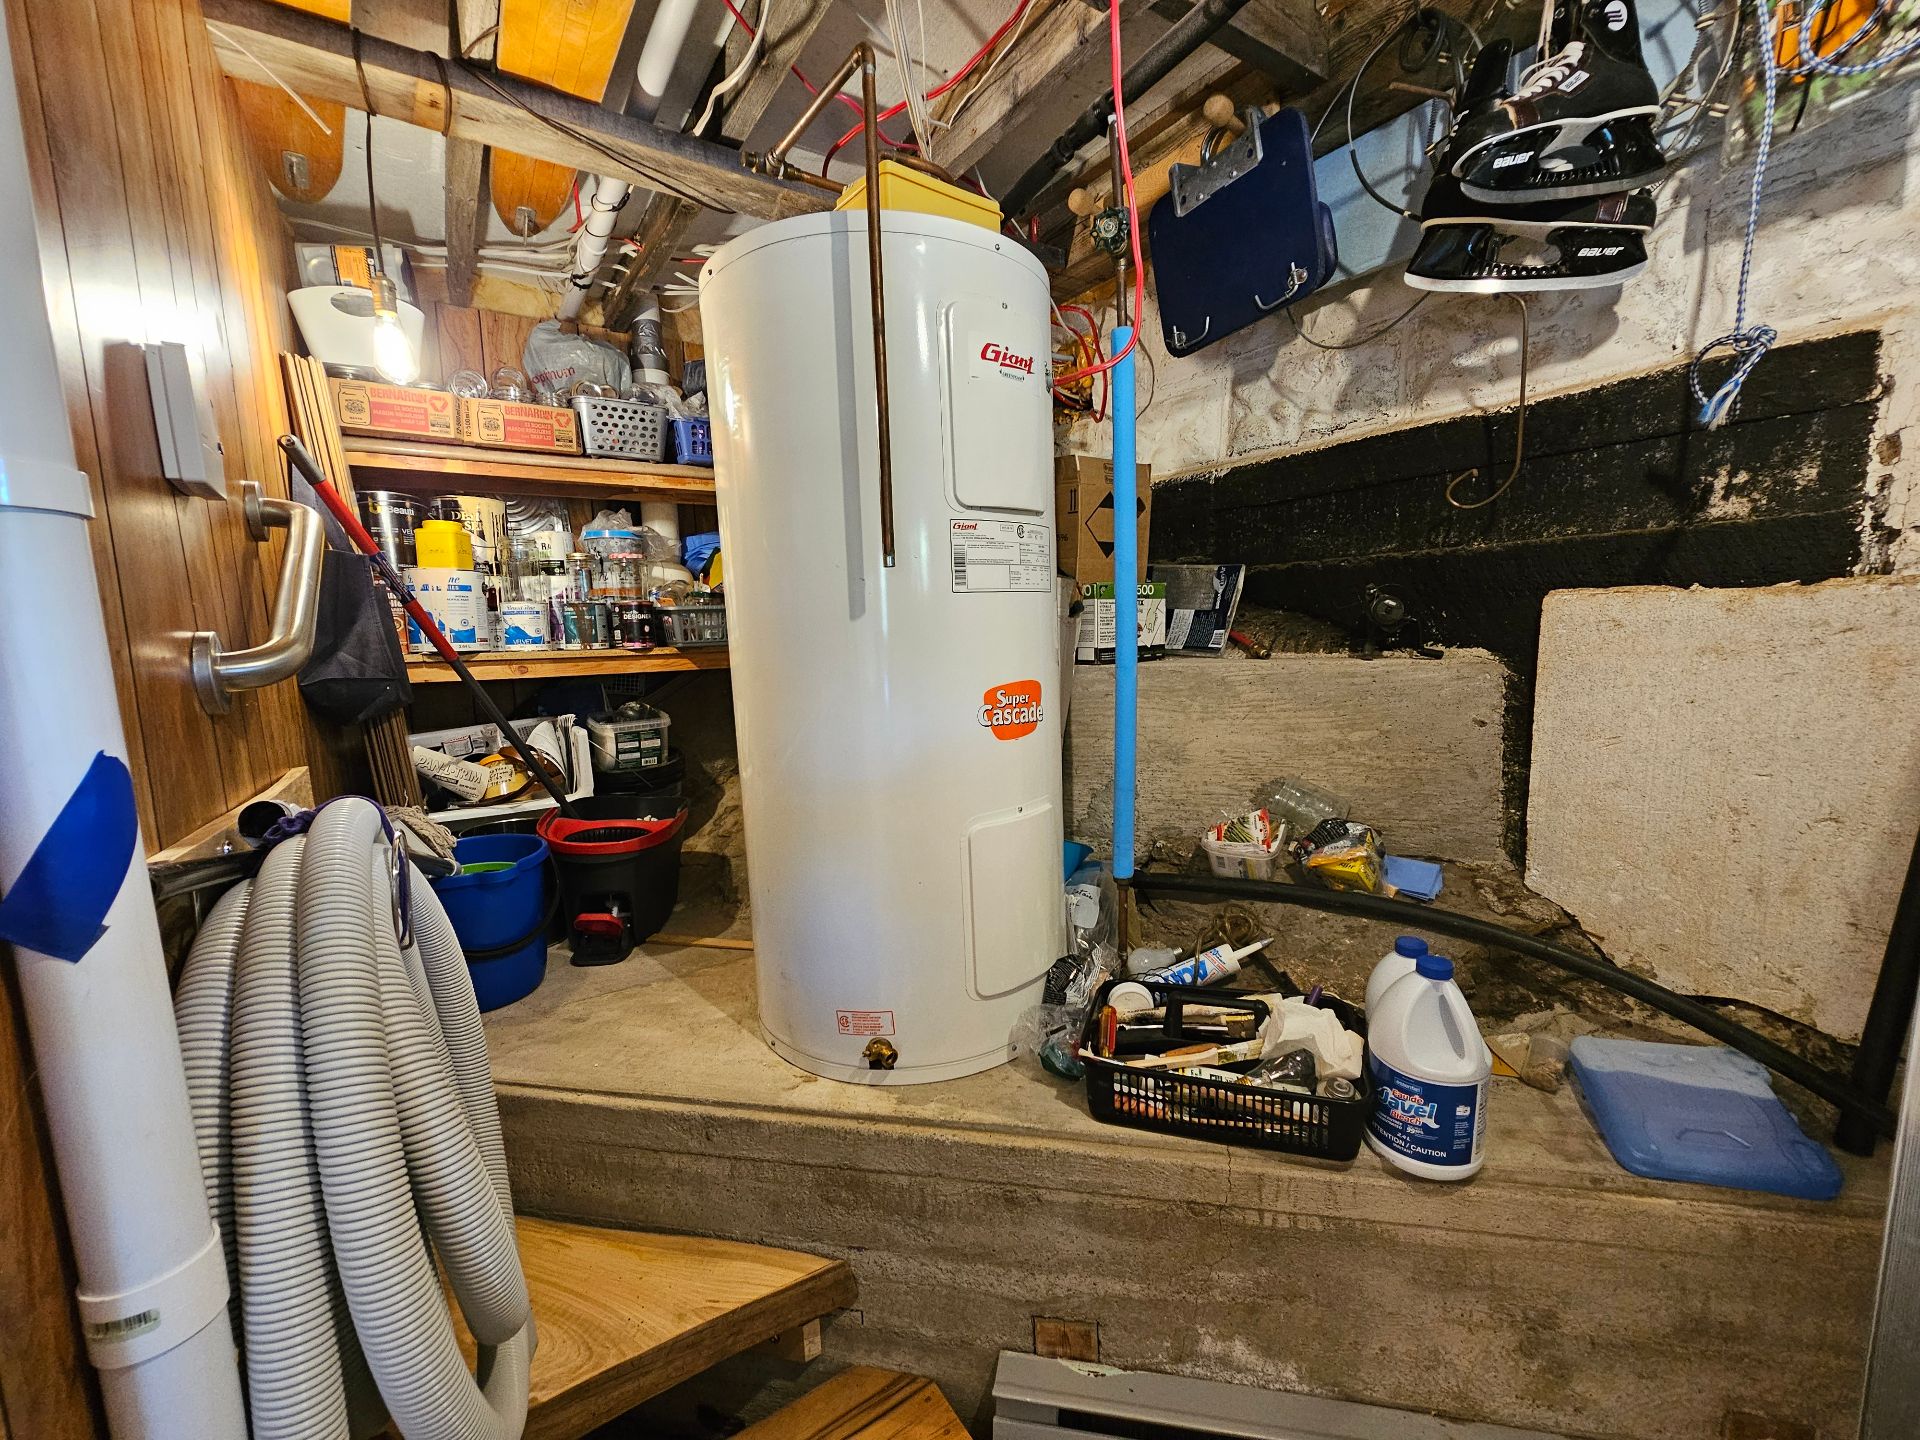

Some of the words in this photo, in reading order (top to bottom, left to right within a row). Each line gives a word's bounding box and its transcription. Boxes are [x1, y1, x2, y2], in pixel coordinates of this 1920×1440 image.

[1577, 246, 1625, 258] BAUER
[980, 342, 1035, 375] Giant
[369, 387, 428, 404] BERNARDIN
[504, 405, 554, 420] BERNARDIN
[952, 522, 978, 531] Giant
[996, 689, 1030, 708] Super
[977, 701, 1044, 727] Cascade
[415, 753, 484, 785] PAN-L-TRIM
[1378, 1086, 1438, 1120] Javel
[1390, 1109, 1423, 1126] Bleach
[1410, 1144, 1447, 1158] CAUTION
